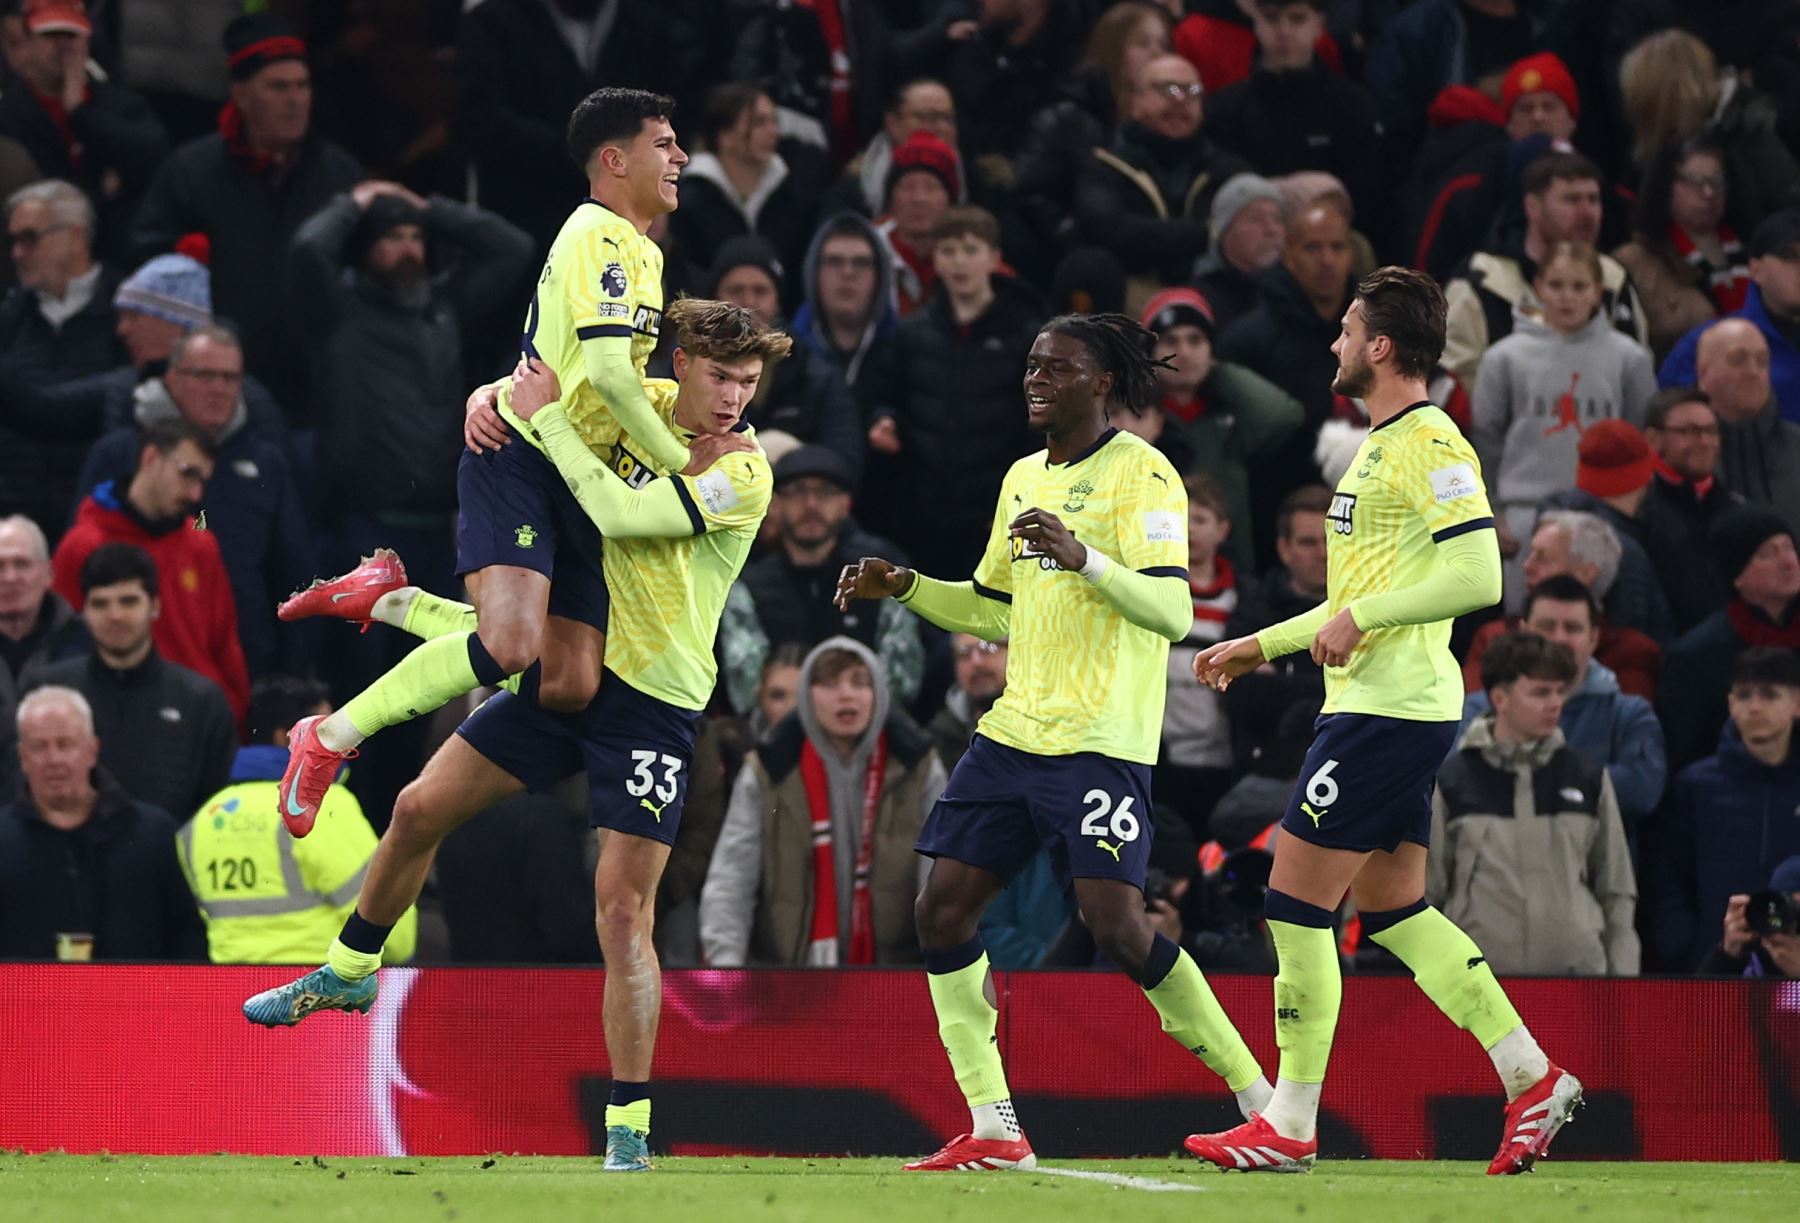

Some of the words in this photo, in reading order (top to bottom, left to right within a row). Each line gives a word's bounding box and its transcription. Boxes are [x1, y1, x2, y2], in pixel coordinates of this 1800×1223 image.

[626, 750, 682, 804] 33
[1306, 759, 1339, 807] 6
[1081, 789, 1139, 842] 26
[207, 857, 256, 890] 120
[1278, 1008, 1299, 1019] SFC
